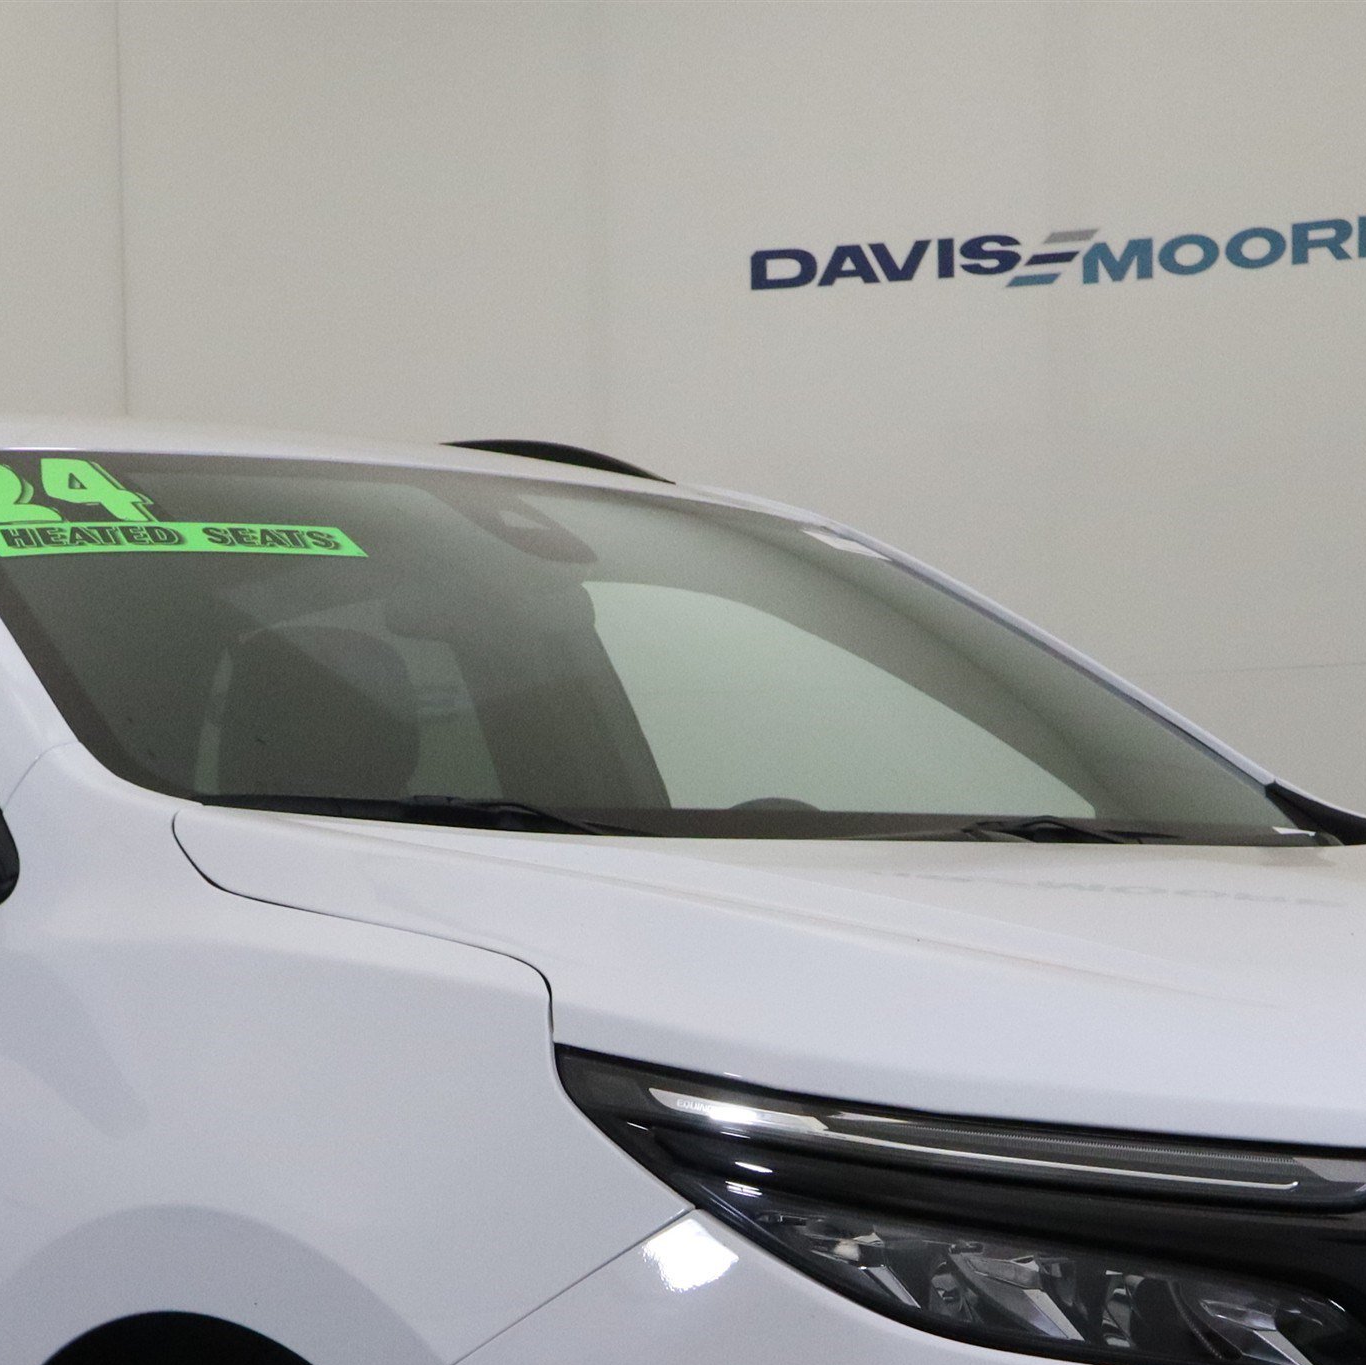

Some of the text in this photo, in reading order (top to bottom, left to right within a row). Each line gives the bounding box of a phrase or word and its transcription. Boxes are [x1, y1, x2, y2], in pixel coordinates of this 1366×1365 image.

[750, 234, 1023, 291] DAVIS
[0, 525, 345, 551] HEATED SEATS
